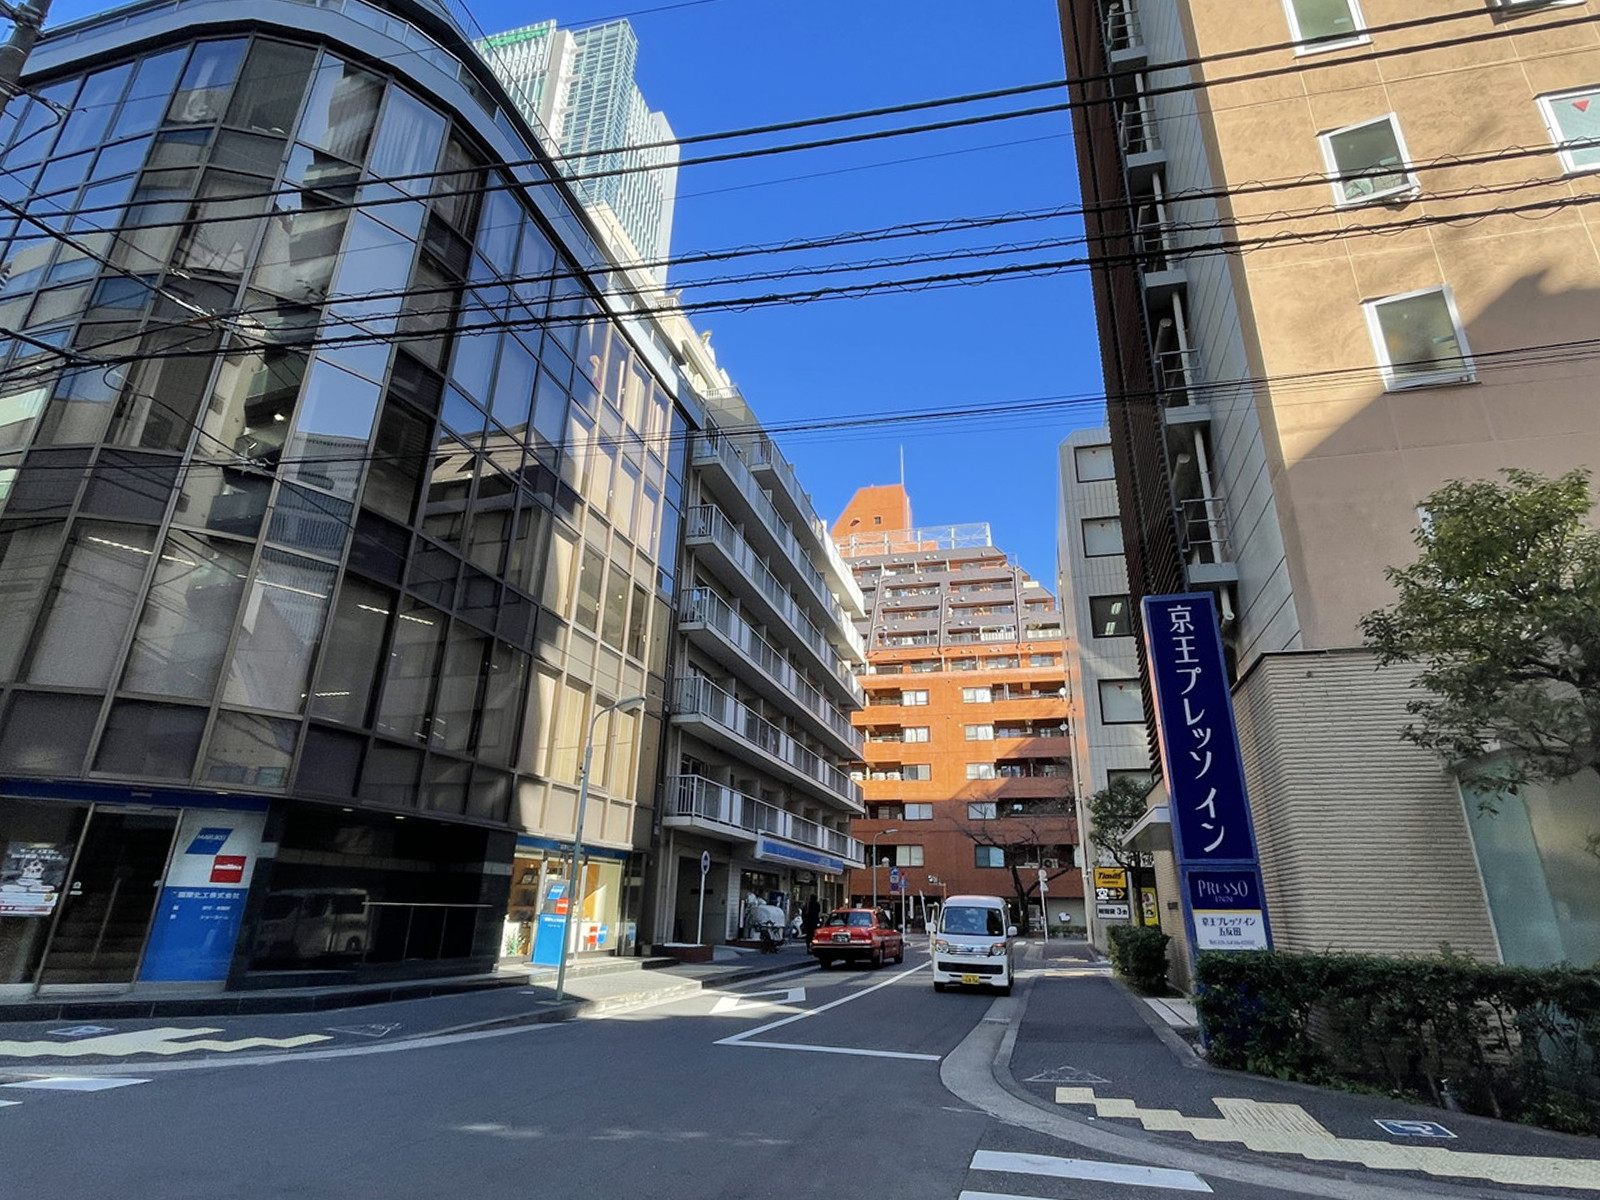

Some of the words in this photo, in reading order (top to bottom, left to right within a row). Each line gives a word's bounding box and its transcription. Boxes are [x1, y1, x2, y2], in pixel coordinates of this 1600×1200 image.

[1167, 604, 1225, 853] 京王プレッソイン
